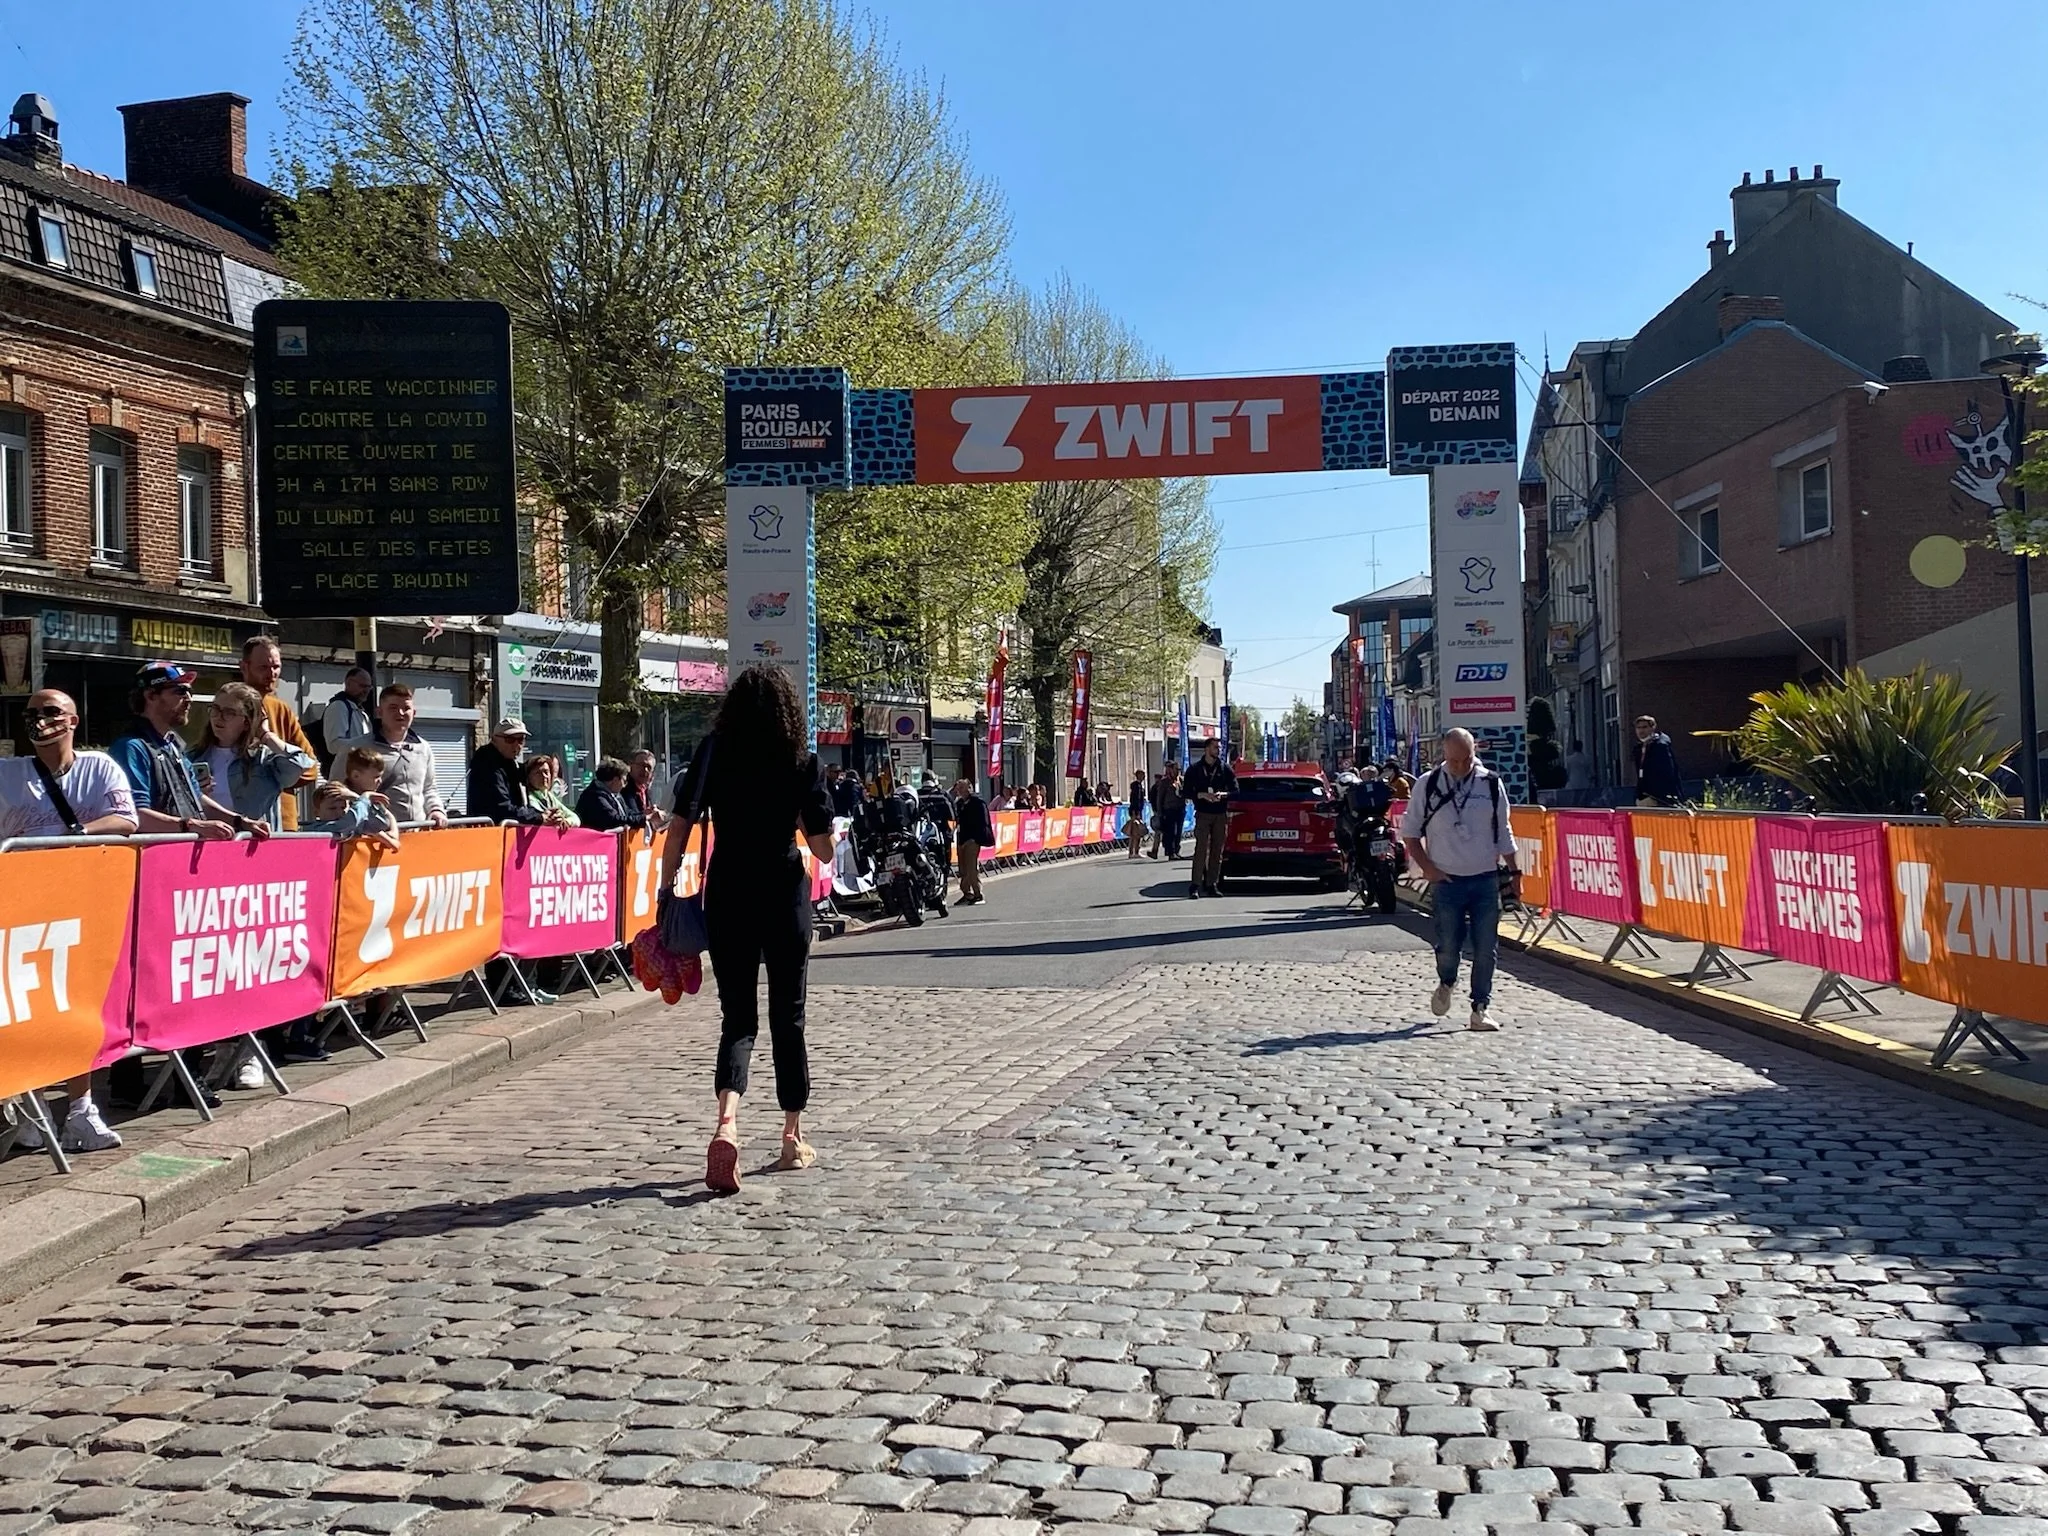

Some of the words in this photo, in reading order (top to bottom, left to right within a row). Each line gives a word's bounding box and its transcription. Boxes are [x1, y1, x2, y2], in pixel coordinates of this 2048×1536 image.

[272, 380, 297, 395] SE
[309, 380, 373, 396] FAIRE
[386, 380, 498, 396] VACCINNER
[1402, 389, 1459, 405] DÉPART
[1462, 389, 1500, 402] 2022
[387, 412, 412, 427] LA
[425, 411, 487, 427] COVID
[741, 403, 800, 420] PARIS
[1429, 405, 1500, 422] DENAIN
[741, 420, 832, 437] ROUBAIX
[1053, 398, 1284, 461] ZWIFT
[273, 444, 350, 461] CENTRE
[363, 444, 437, 460] OUVERT
[452, 444, 476, 459] DE
[743, 440, 786, 448] FEMMES
[791, 439, 826, 449] ZWIFT
[340, 477, 376, 492] 17H
[389, 476, 439, 492] SANS
[452, 476, 489, 491] RDV
[275, 510, 300, 525] DU
[313, 510, 374, 525] LUNDI
[390, 509, 415, 524] AU
[427, 508, 500, 523] SAMEDI
[302, 542, 365, 557] SALLE
[378, 541, 416, 556] DES
[316, 574, 379, 589] PLACE
[392, 573, 468, 588] BAUDIN
[44, 611, 117, 642] GRILL
[134, 619, 231, 650] ALIBABA
[1458, 666, 1489, 680] FDJ
[1453, 701, 1513, 710] lastminute.com
[1267, 762, 1296, 770] ZWIFT
[1565, 833, 1600, 860] WATCH
[1596, 835, 1617, 861] THE
[529, 855, 581, 885] WATCH
[581, 854, 609, 884] THE
[1770, 847, 1823, 888] WATCH
[1823, 852, 1858, 891] THE
[1569, 859, 1623, 898] FEMMES
[1659, 850, 1728, 908] ZWIFT
[173, 883, 264, 936] WATCH
[265, 880, 307, 923] THE
[403, 868, 491, 940] ZWIFT
[528, 883, 608, 929] FEMMES
[1775, 882, 1863, 943] FEMMES
[171, 922, 311, 1004] FEMMES
